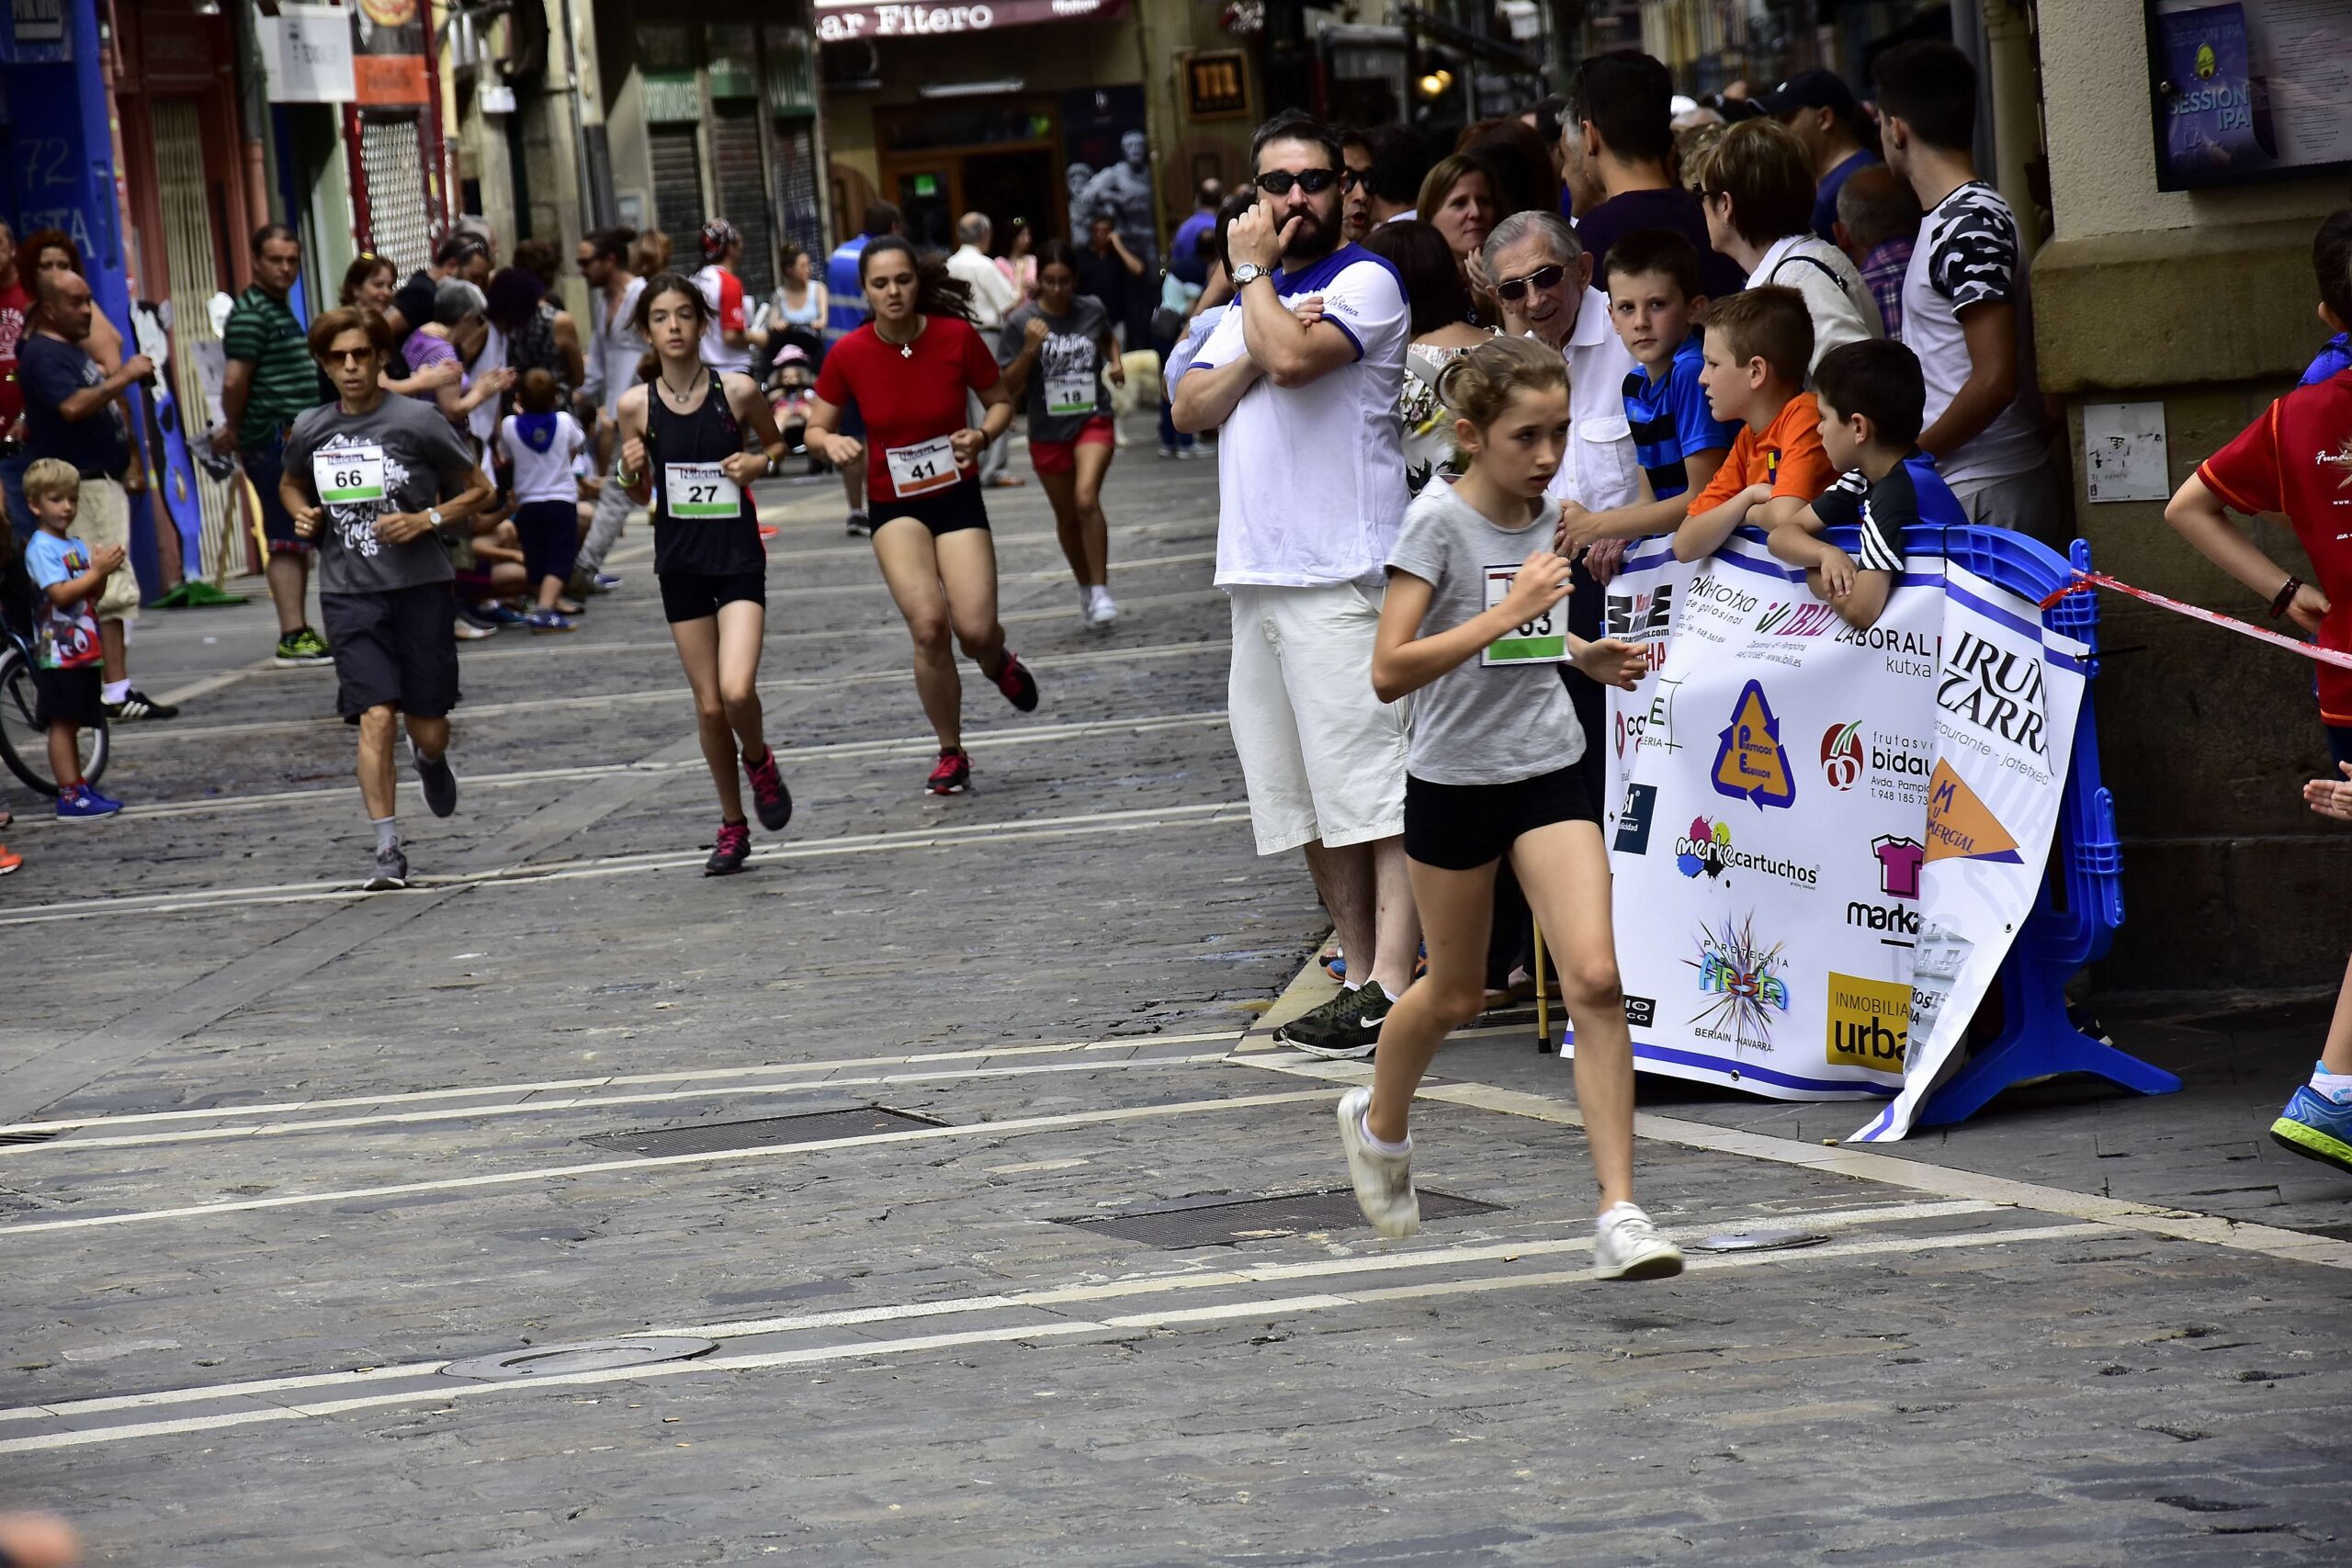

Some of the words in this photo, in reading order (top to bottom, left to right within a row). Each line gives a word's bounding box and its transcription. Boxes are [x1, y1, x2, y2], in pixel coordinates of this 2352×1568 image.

[816, 13, 865, 41] ar
[874, 5, 993, 35] Fitero
[2169, 87, 2249, 116] SESSION
[2220, 107, 2250, 130] IPA
[18, 139, 79, 191] 72
[1060, 389, 1081, 405] 18
[334, 469, 362, 489] 66
[910, 460, 935, 480] 41
[688, 485, 718, 503] 27
[359, 539, 379, 558] 35
[1697, 604, 1744, 625] golosinas
[1835, 626, 1930, 657] LABORAL
[1886, 656, 1930, 678] kutxa
[1871, 775, 1894, 788] Avda.
[1878, 790, 1894, 801] 948
[1898, 793, 1915, 805] 185
[1703, 940, 1790, 968] PIROTECNIA
[1694, 1027, 1732, 1043] BERIAIN
